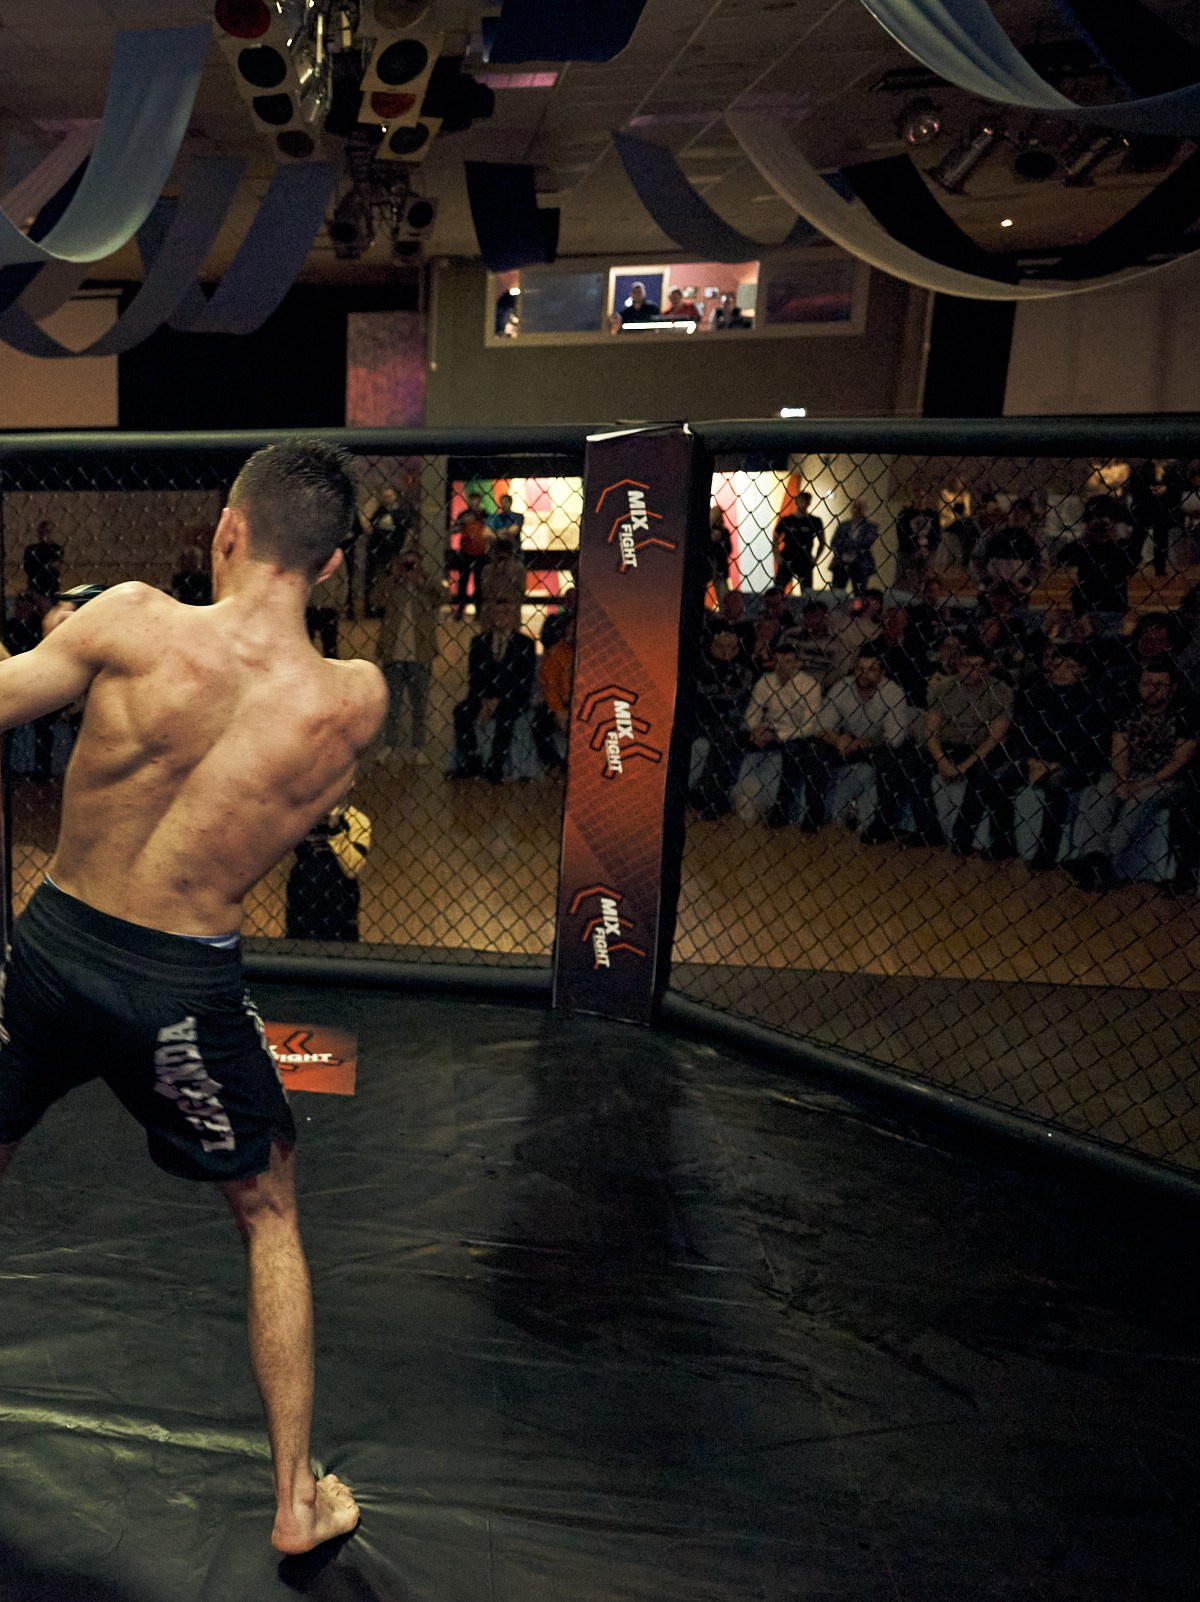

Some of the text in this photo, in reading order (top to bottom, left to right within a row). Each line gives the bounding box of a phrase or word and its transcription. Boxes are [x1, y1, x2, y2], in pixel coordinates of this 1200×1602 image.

[628, 490, 649, 531] MIX
[620, 523, 638, 568] FIGHT
[613, 700, 634, 740] MIX
[605, 731, 623, 774] FIGHT
[601, 898, 621, 937] MIX
[593, 926, 611, 968] FIGHT
[277, 1053, 333, 1063] IGHT
